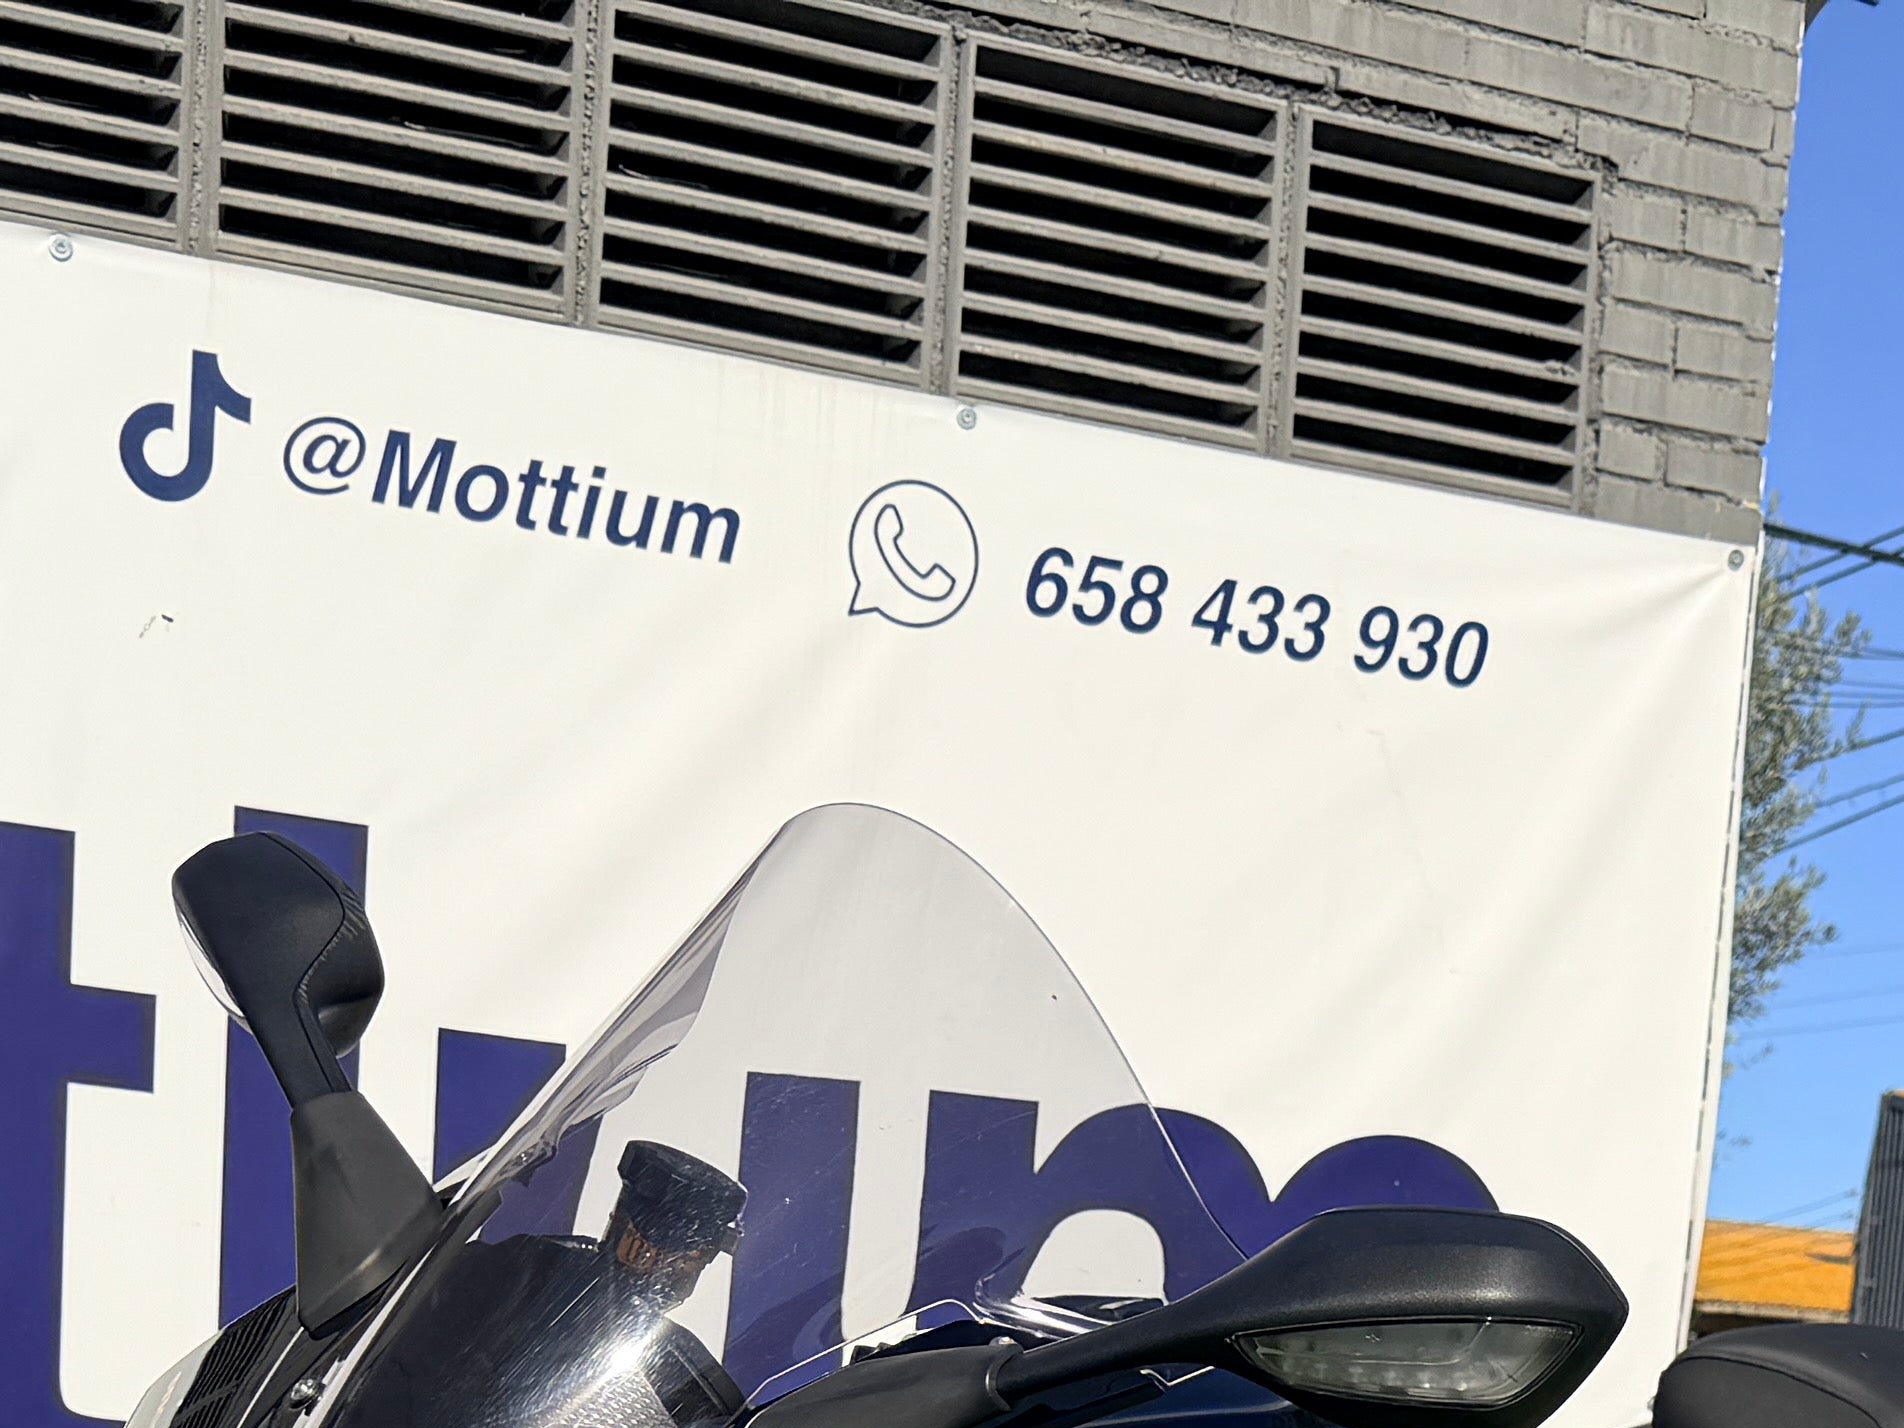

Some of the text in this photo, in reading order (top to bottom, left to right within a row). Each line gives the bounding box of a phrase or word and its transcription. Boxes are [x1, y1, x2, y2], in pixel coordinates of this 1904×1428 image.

[282, 416, 741, 564] @Mottium
[1025, 546, 1489, 689] 658 433 930
